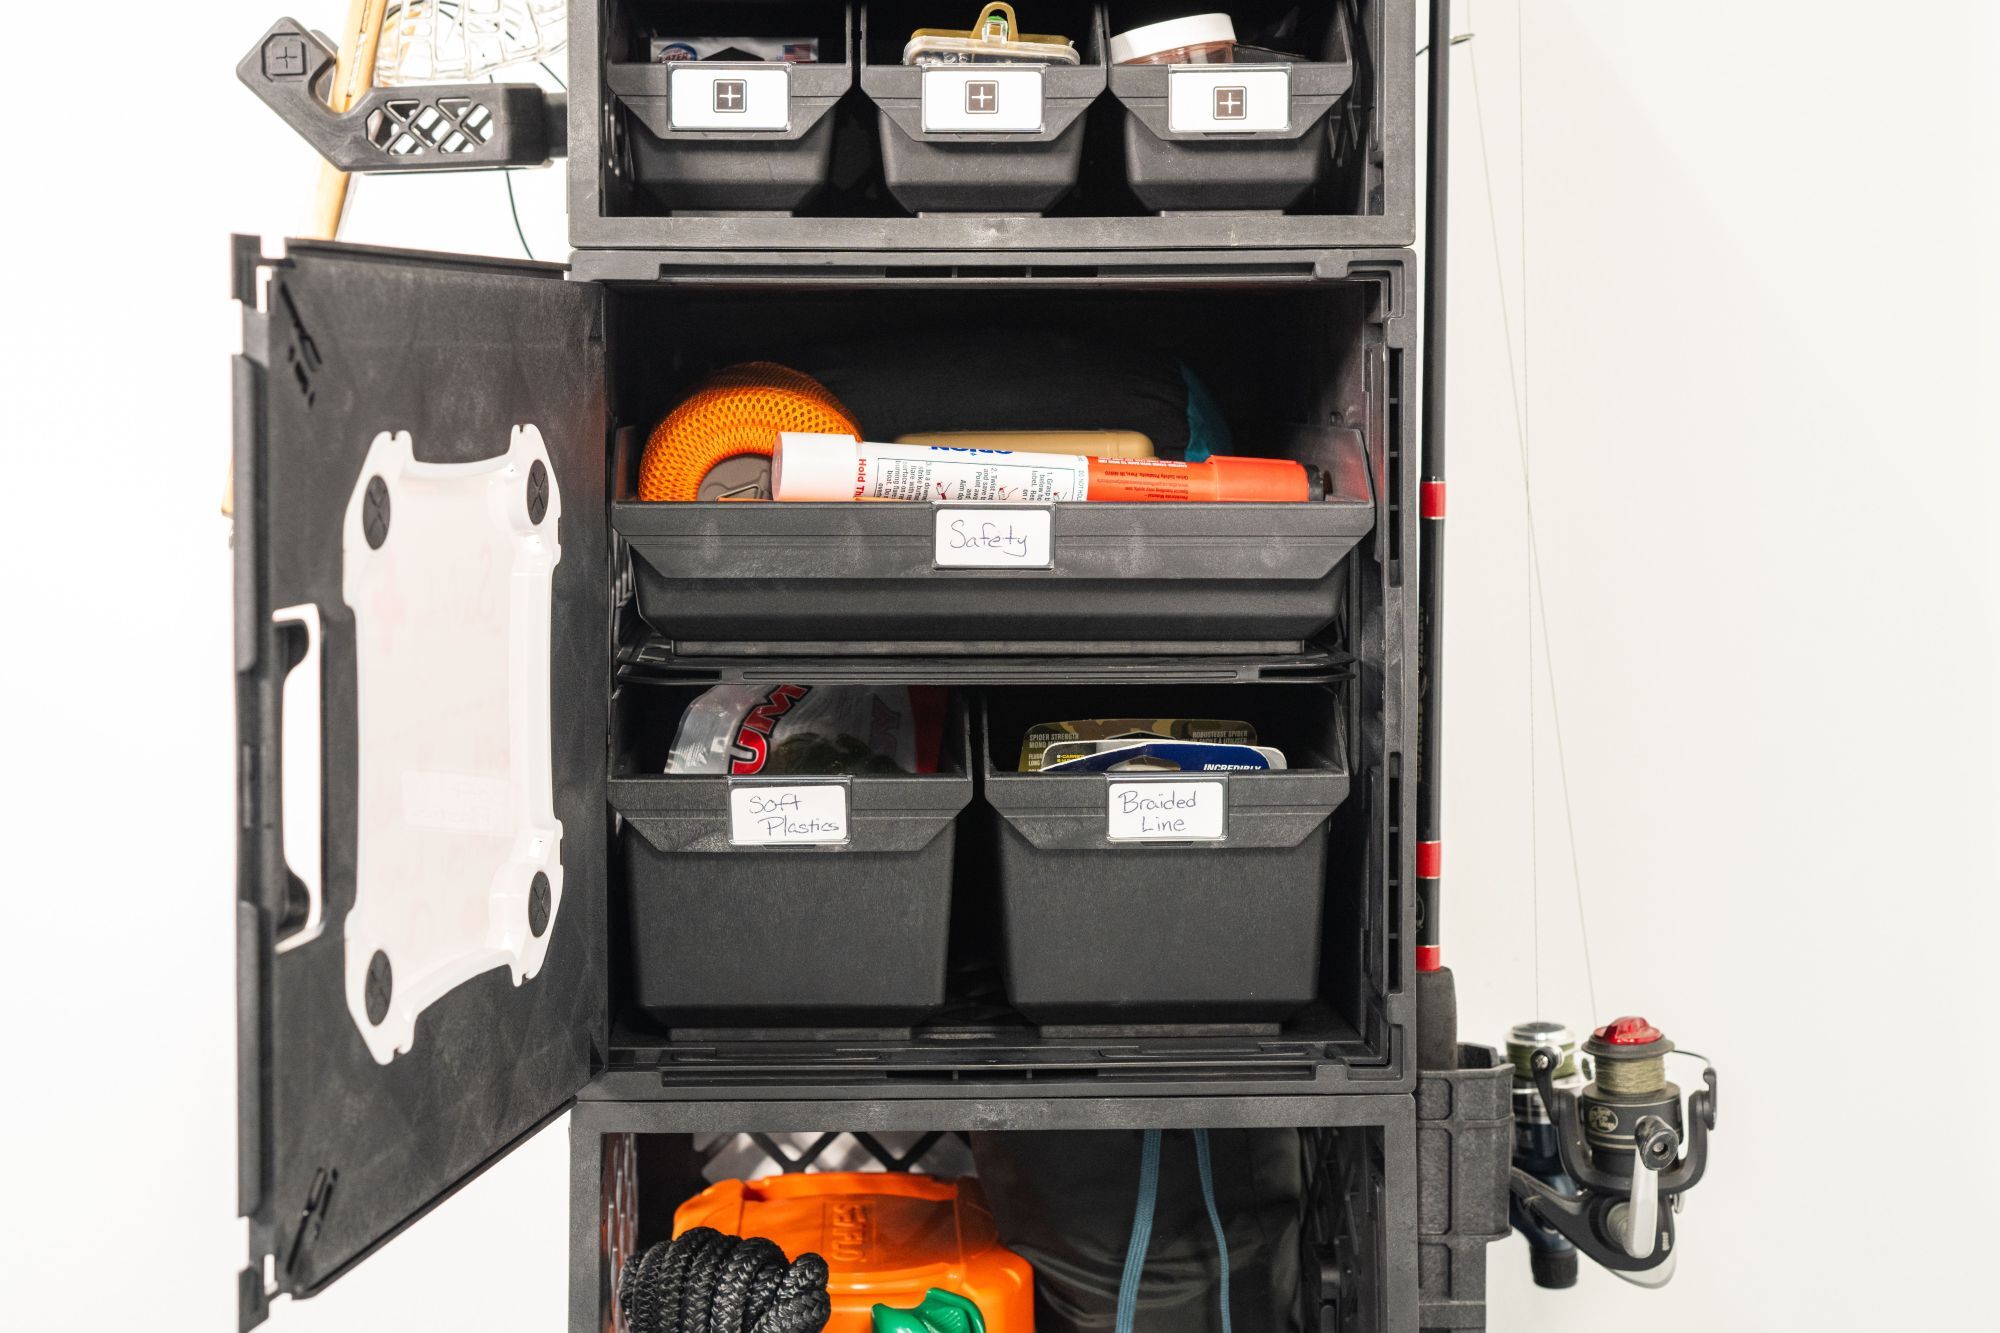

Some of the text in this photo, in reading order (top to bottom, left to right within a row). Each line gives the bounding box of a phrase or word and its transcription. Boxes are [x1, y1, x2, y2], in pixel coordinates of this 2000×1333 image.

[855, 459, 866, 498] Hold Th
[893, 460, 901, 484] burning
[901, 461, 909, 484] surface
[917, 466, 925, 484] strike
[974, 471, 982, 488] Point
[1044, 478, 1053, 496] Grasp
[949, 519, 1027, 557] Safety
[749, 793, 803, 814] Soft
[1118, 790, 1197, 814] Braided
[757, 815, 839, 836] Plastics
[1142, 815, 1187, 832] Line
